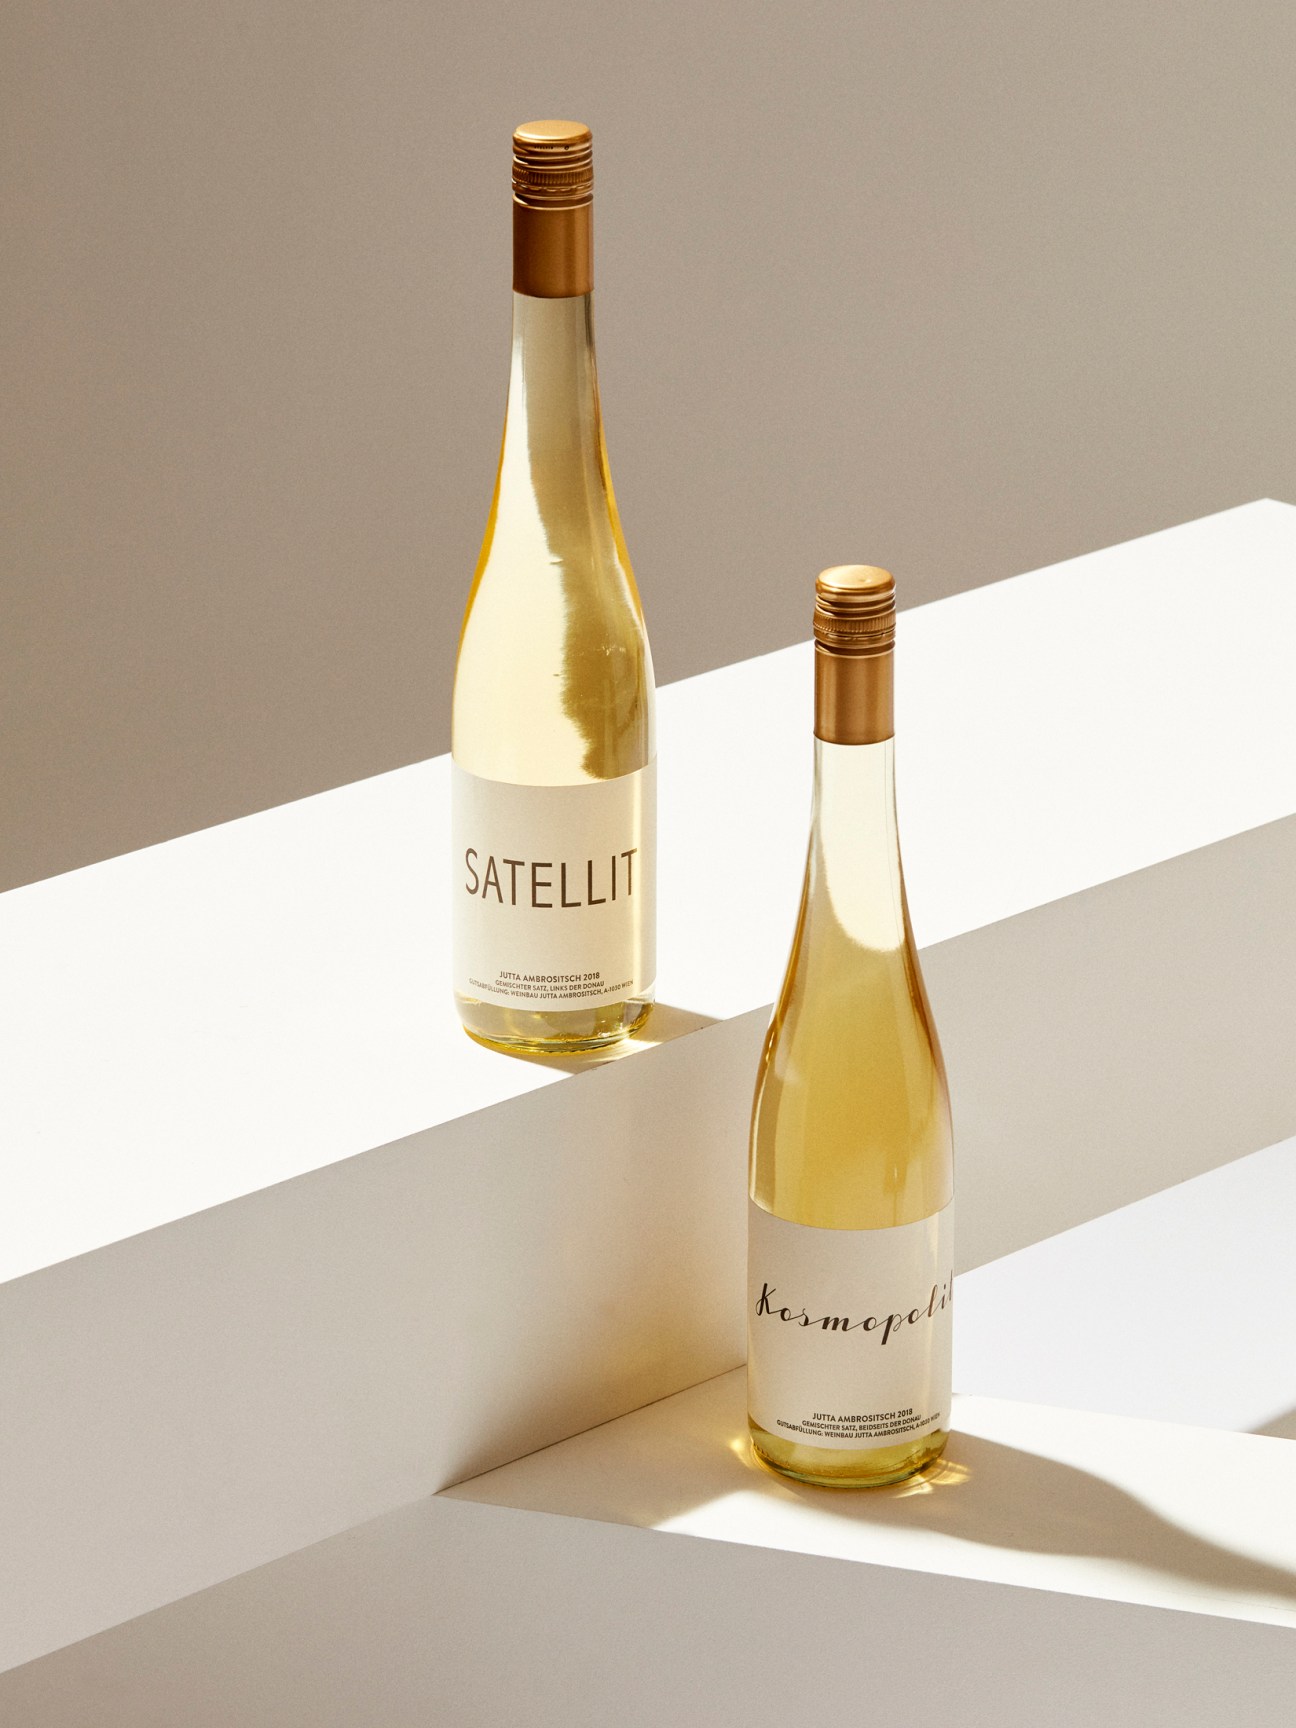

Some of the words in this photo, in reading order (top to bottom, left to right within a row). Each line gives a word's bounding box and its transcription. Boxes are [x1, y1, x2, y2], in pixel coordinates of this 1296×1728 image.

[465, 847, 638, 908] SATELLIT
[495, 979, 532, 991] GEMISCHTER
[583, 980, 605, 989] DONAU
[500, 971, 521, 981] JUTTA
[522, 974, 582, 983] AMBROSITSCH
[583, 972, 600, 981] 2018
[510, 990, 539, 998] WEINBAU
[558, 988, 603, 999] AMBROSITSCH,
[621, 979, 634, 988] WIEN
[802, 1420, 840, 1431] GEMISCHTER
[858, 1422, 889, 1431] BEIDSEITS
[889, 1420, 902, 1428] DER
[902, 1414, 922, 1425] DONAU
[812, 1413, 836, 1422] JUTTA
[837, 1412, 896, 1423] AMBROSITSCH
[897, 1408, 913, 1418] 2018
[776, 1419, 823, 1436] GUTSABFÜLLUNG:
[873, 1424, 915, 1437] AMBROSITSCH,
